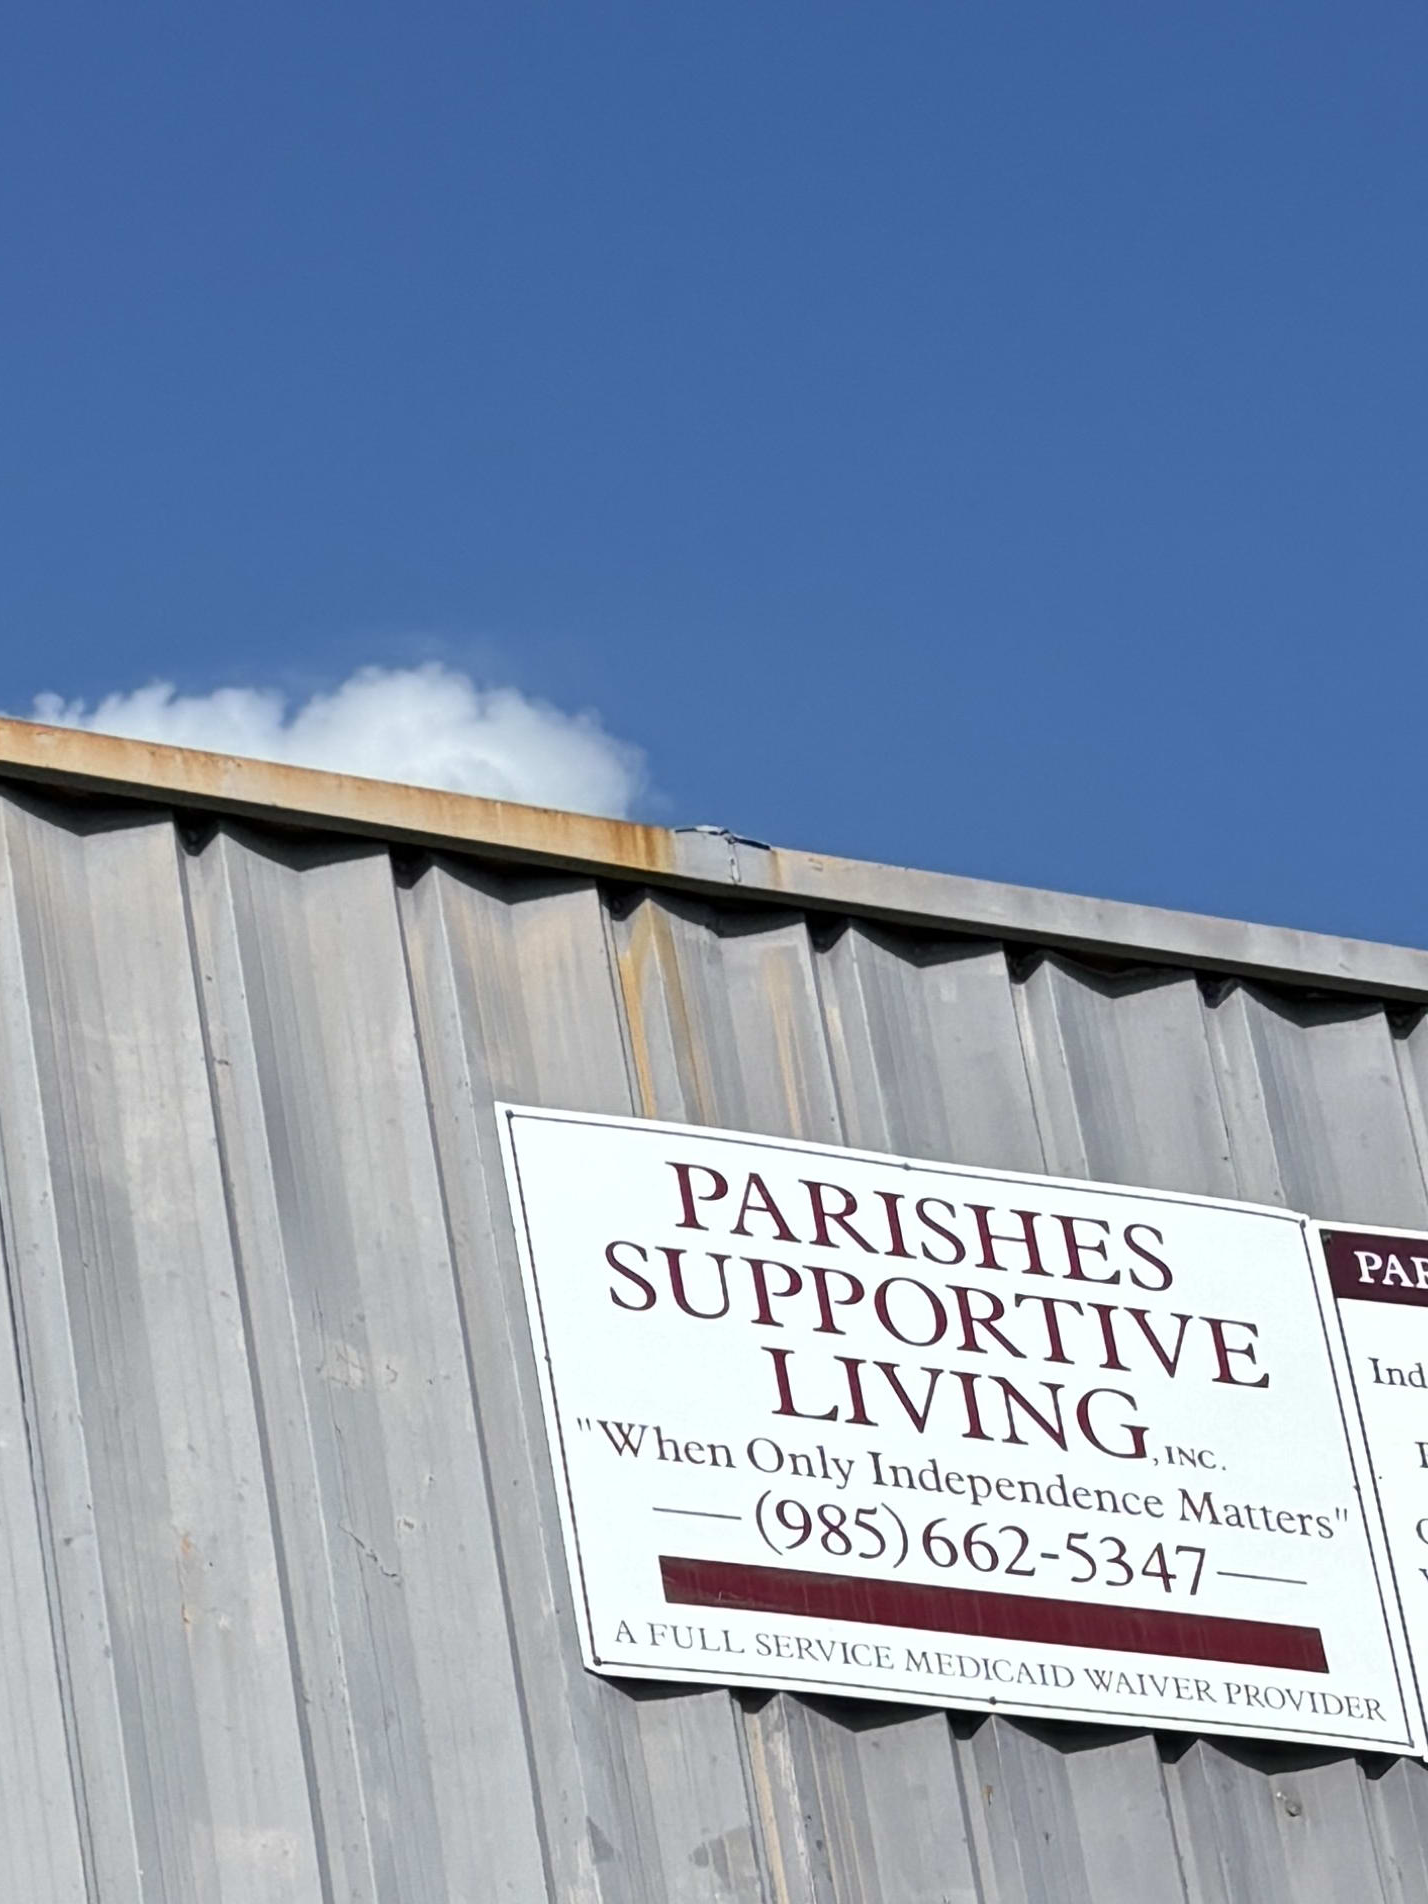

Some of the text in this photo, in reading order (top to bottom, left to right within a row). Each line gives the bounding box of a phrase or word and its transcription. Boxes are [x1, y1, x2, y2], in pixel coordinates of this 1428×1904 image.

[665, 1160, 1175, 1293] PARISHES
[603, 1240, 1271, 1389] SUPPORTIVE
[576, 1418, 1350, 1541] "When Only Independence Matters"
[1166, 1443, 1227, 1473] INC.
[613, 1619, 1388, 1723] A FULL SERVICE MEDICAID WAIVER PROVIDER
